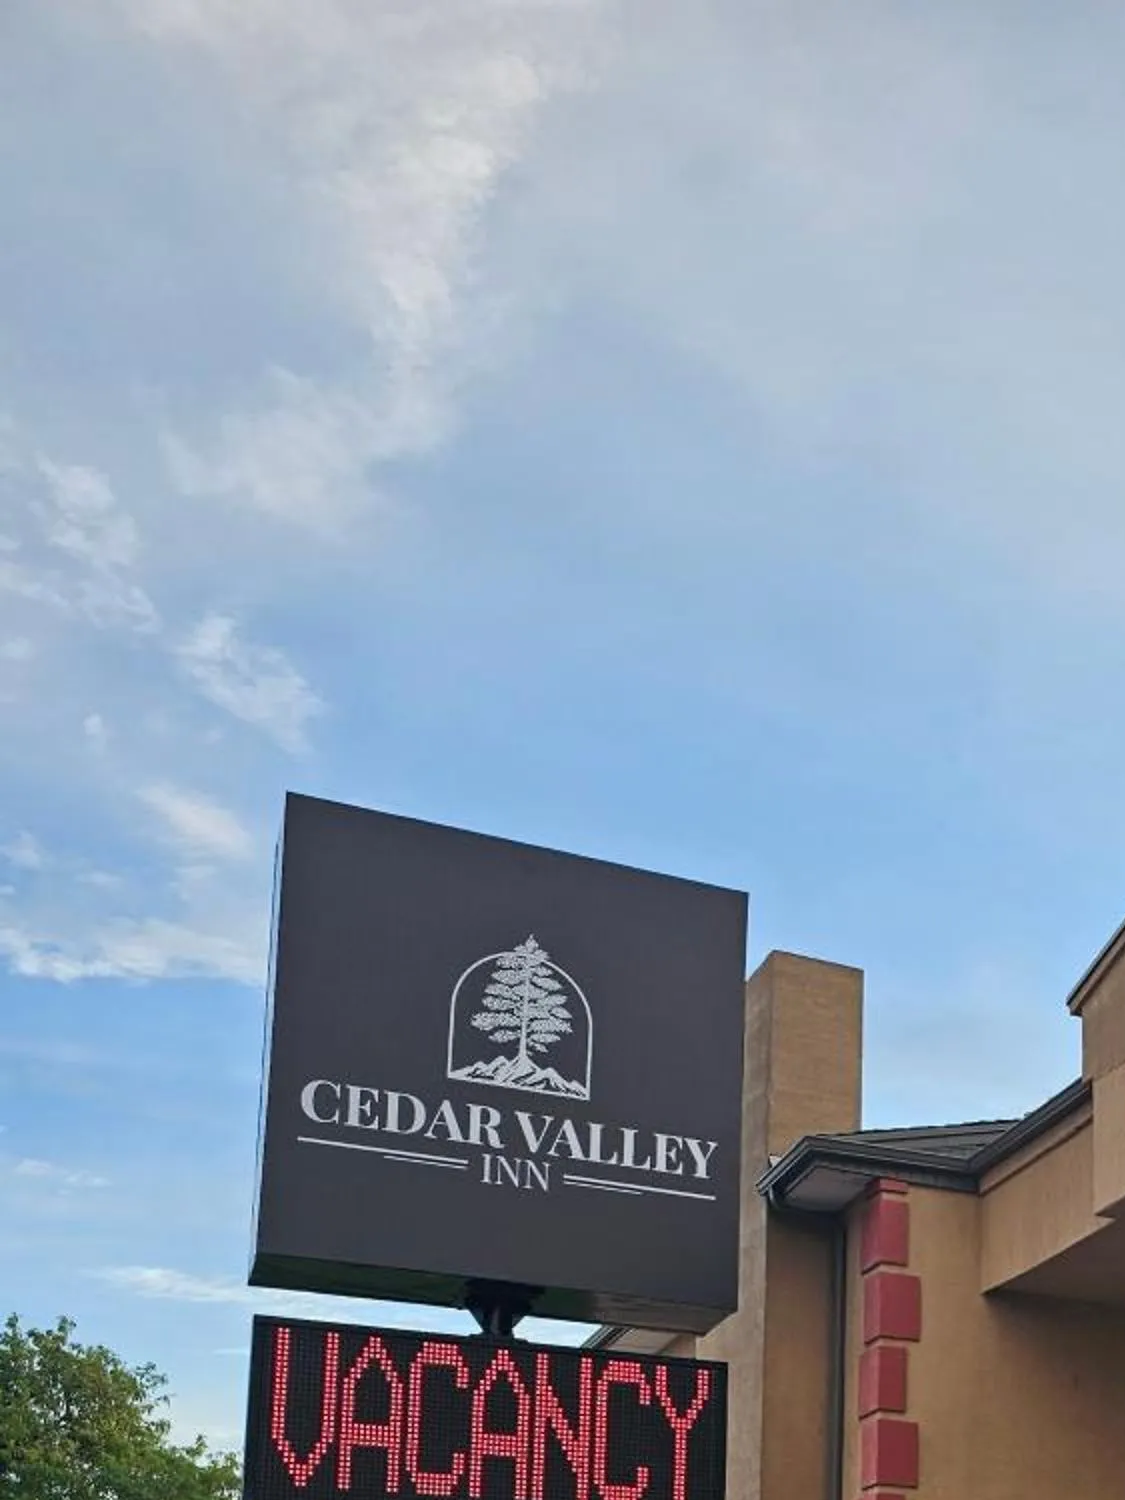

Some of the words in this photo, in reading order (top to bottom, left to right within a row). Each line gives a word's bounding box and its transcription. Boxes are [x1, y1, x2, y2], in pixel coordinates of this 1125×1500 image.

[300, 1078, 505, 1149] CEDAR
[513, 1110, 719, 1179] VALLEY
[480, 1153, 550, 1192] INN
